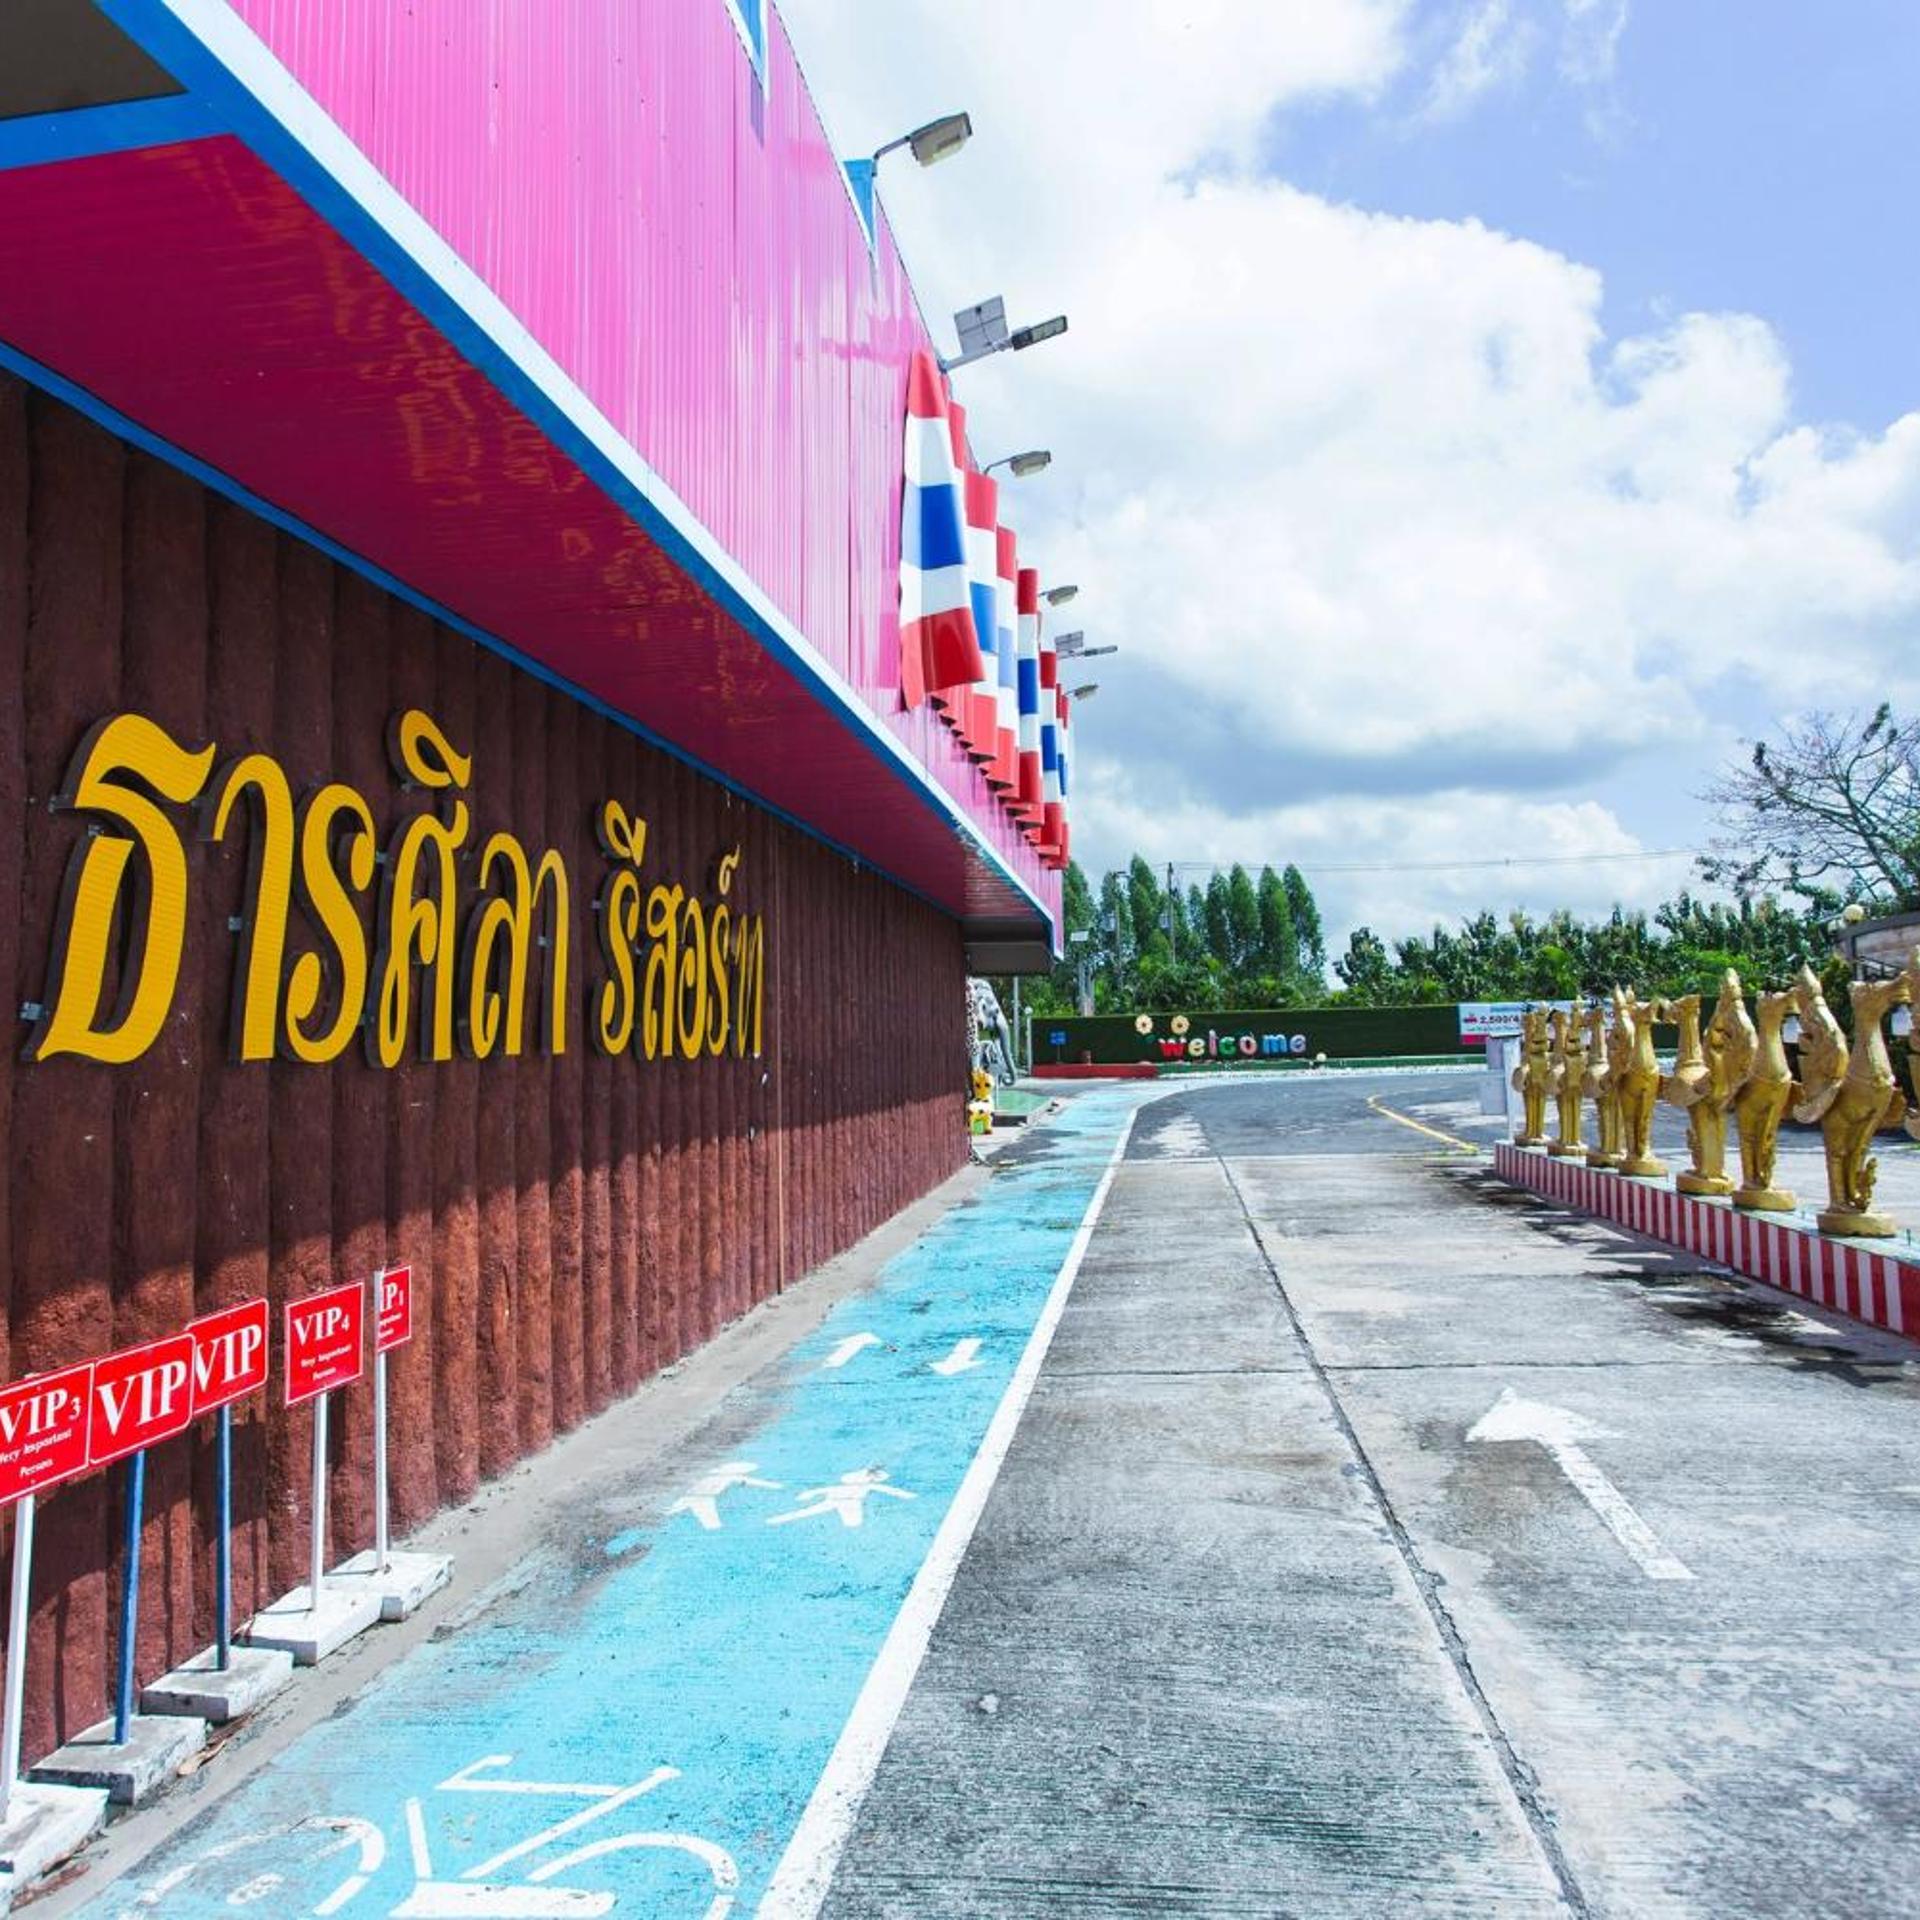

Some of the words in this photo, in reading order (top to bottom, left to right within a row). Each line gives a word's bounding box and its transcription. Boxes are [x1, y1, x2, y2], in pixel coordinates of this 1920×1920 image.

[601, 799, 763, 1060] รีสอร์ท
[1158, 1029, 1307, 1057] welcome
[195, 1324, 262, 1392] VIP
[96, 1360, 187, 1436] VIP
